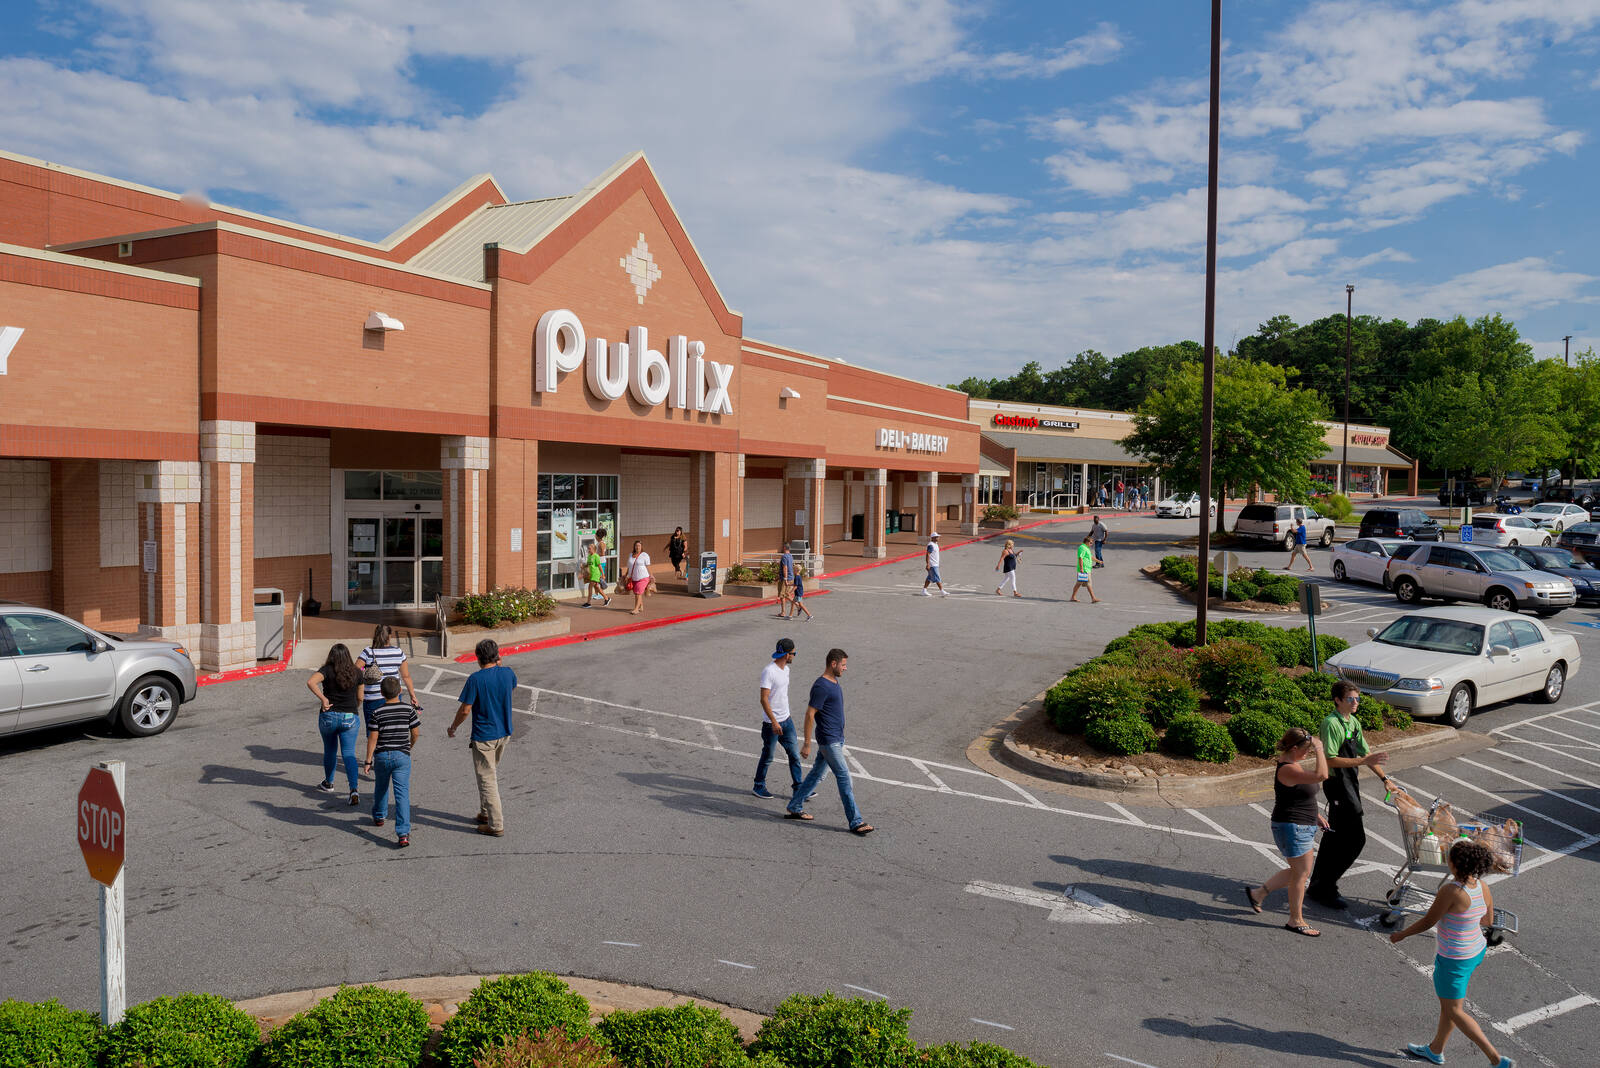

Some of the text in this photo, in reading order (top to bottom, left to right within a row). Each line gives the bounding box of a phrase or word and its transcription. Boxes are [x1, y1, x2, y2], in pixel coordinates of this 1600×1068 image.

[536, 309, 734, 415] Publix
[880, 428, 949, 453] DELI BAKERY
[1043, 420, 1078, 429] GRILLE
[80, 799, 121, 852] STOP
